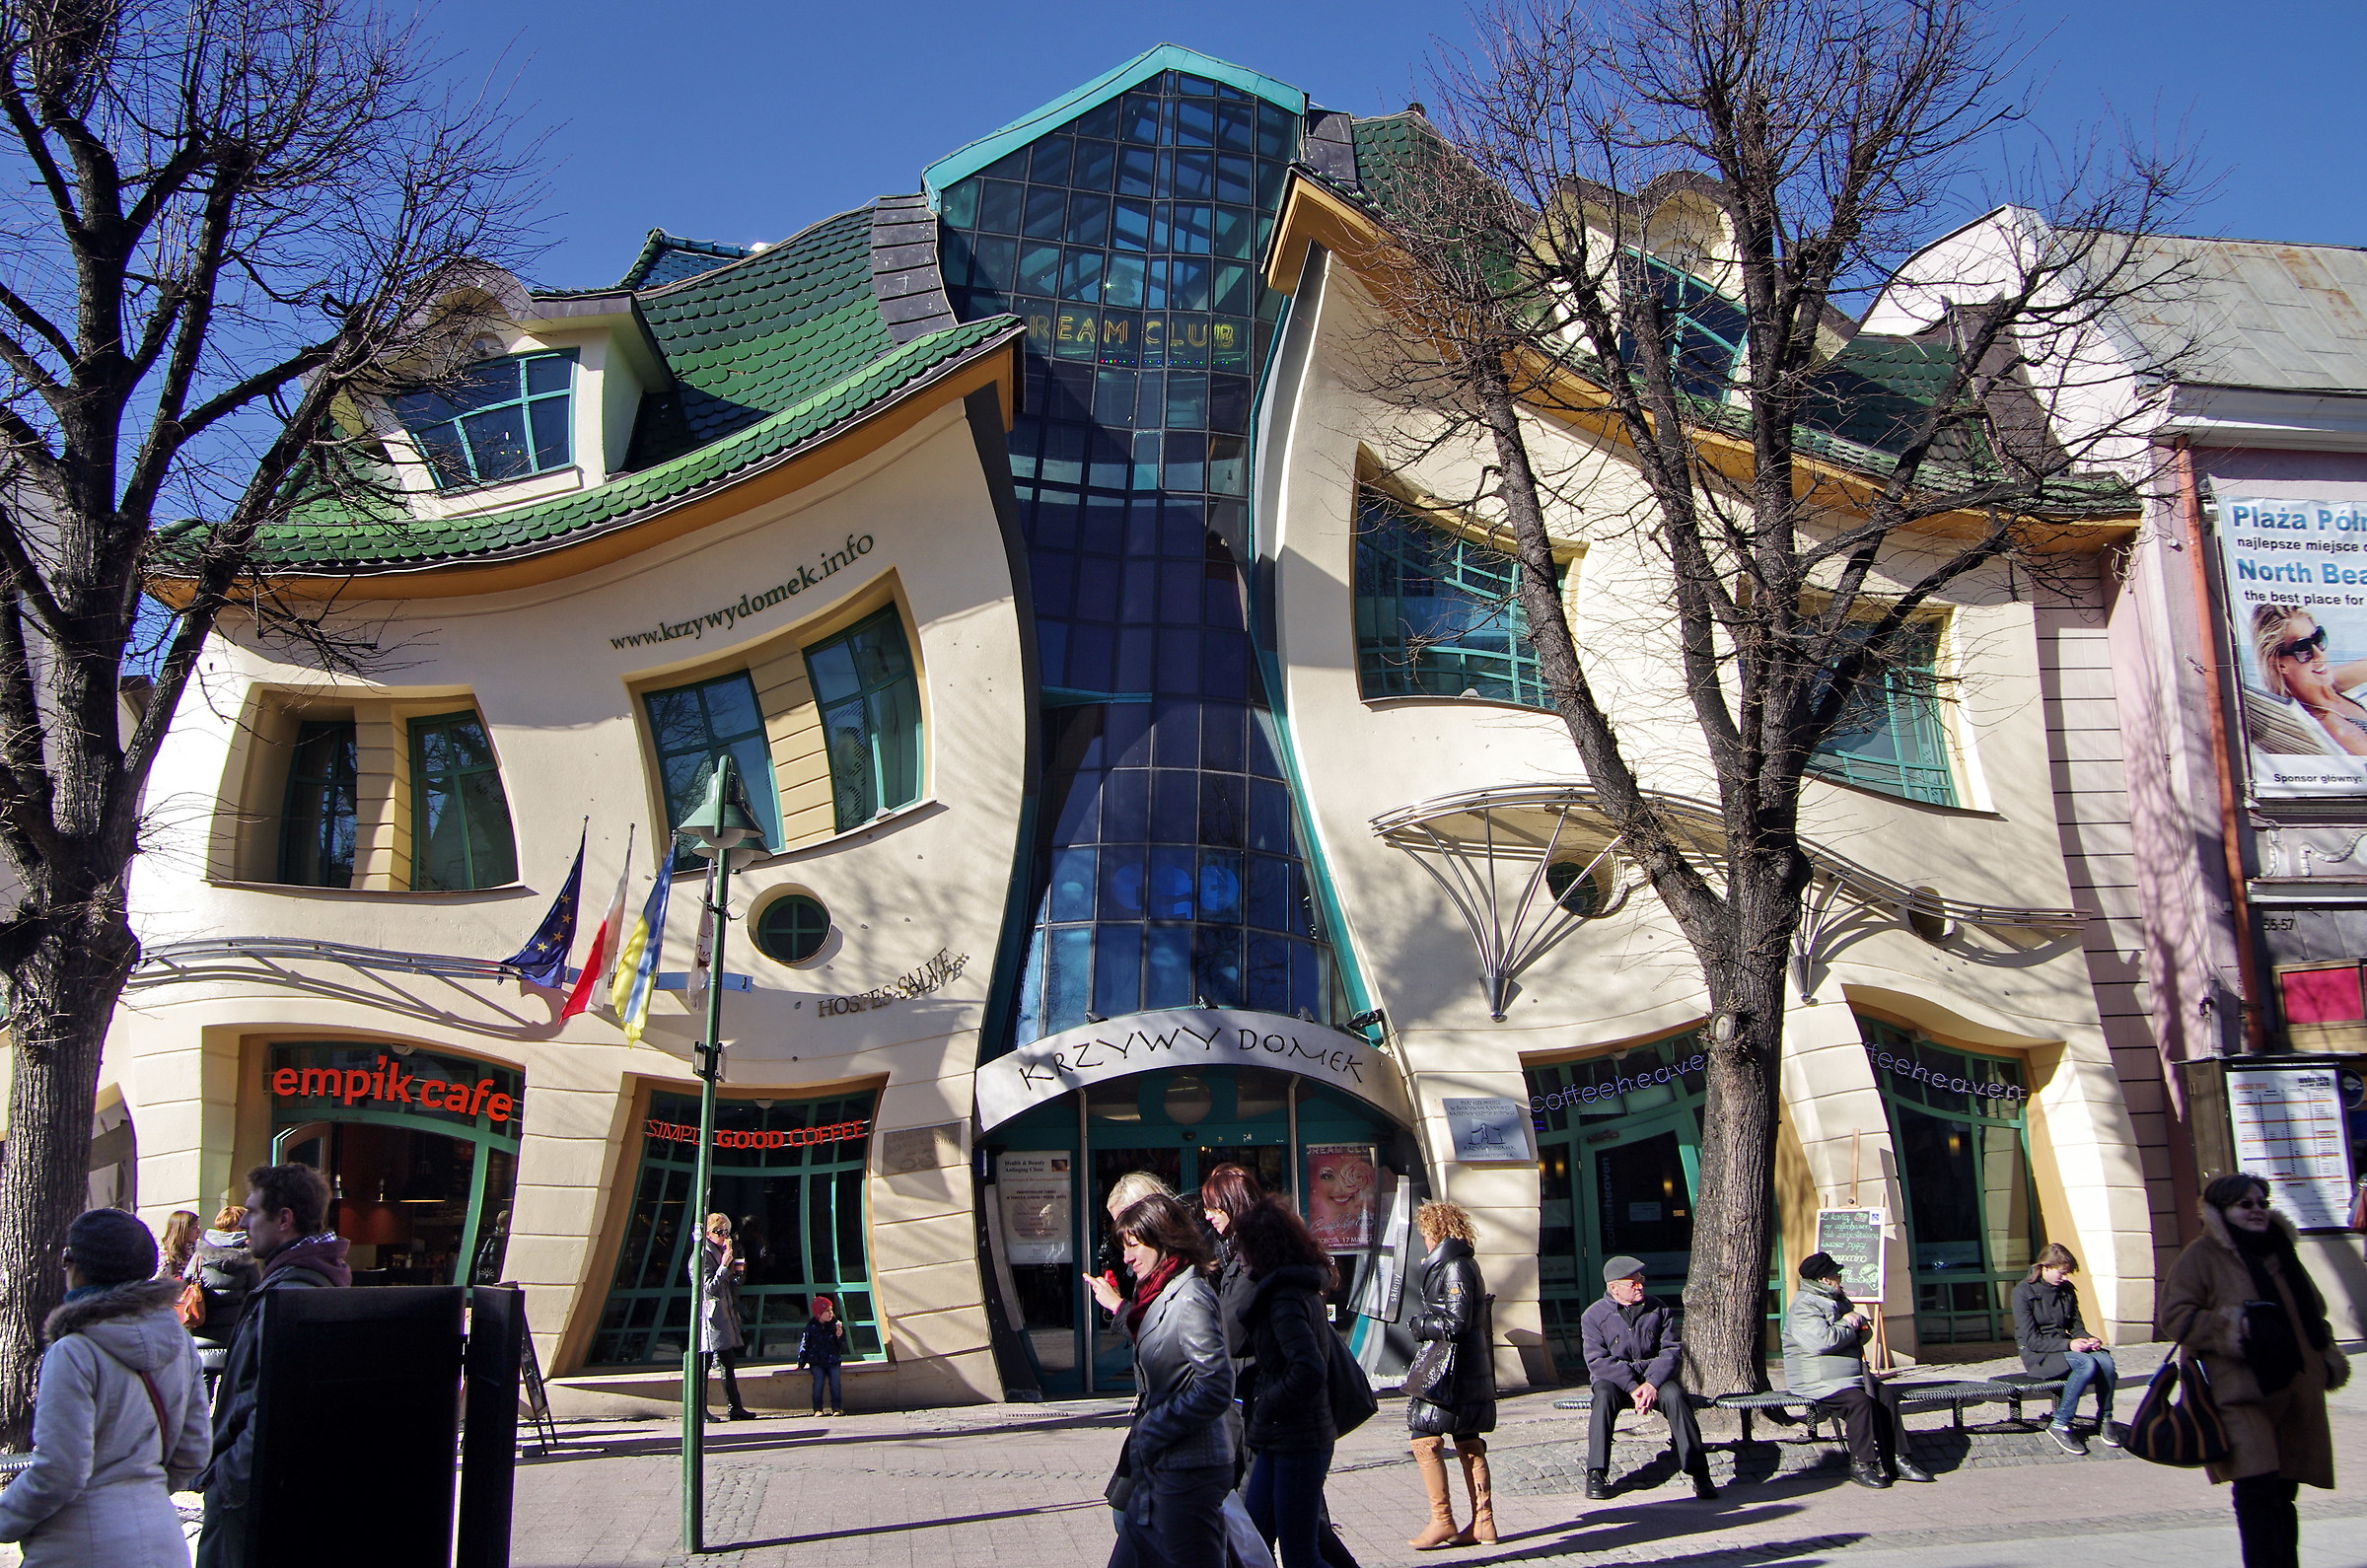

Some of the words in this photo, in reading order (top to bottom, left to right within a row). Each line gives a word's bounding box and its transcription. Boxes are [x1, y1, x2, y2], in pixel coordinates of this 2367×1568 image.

[1029, 315, 1128, 344] REAM
[1145, 320, 1234, 347] CLUB
[2232, 505, 2308, 531] Plaża
[2237, 536, 2302, 551] najlepsze
[2306, 539, 2359, 554] miejsce
[2236, 558, 2313, 583] North
[610, 534, 875, 650] www.krzywydomek.info
[2245, 590, 2266, 602] the
[2270, 591, 2300, 604] best
[2304, 593, 2341, 606] place
[2345, 594, 2364, 606] for
[2273, 773, 2318, 784] Sponsor
[817, 984, 893, 1018] HOSPES
[897, 946, 954, 1000] SALVE
[1018, 1026, 1222, 1092] KRZYWY
[1238, 1028, 1364, 1084] DOMEK
[271, 1054, 415, 1106] empik
[419, 1078, 514, 1122] cafe
[1530, 1054, 1705, 1113] coffeeheave
[646, 1118, 701, 1146] SIMPL
[716, 1129, 785, 1150] GOOD
[789, 1119, 866, 1148] COFFEE
[1602, 1157, 1617, 1247] coffeeheaven
[1390, 1273, 1402, 1303] sklepy
